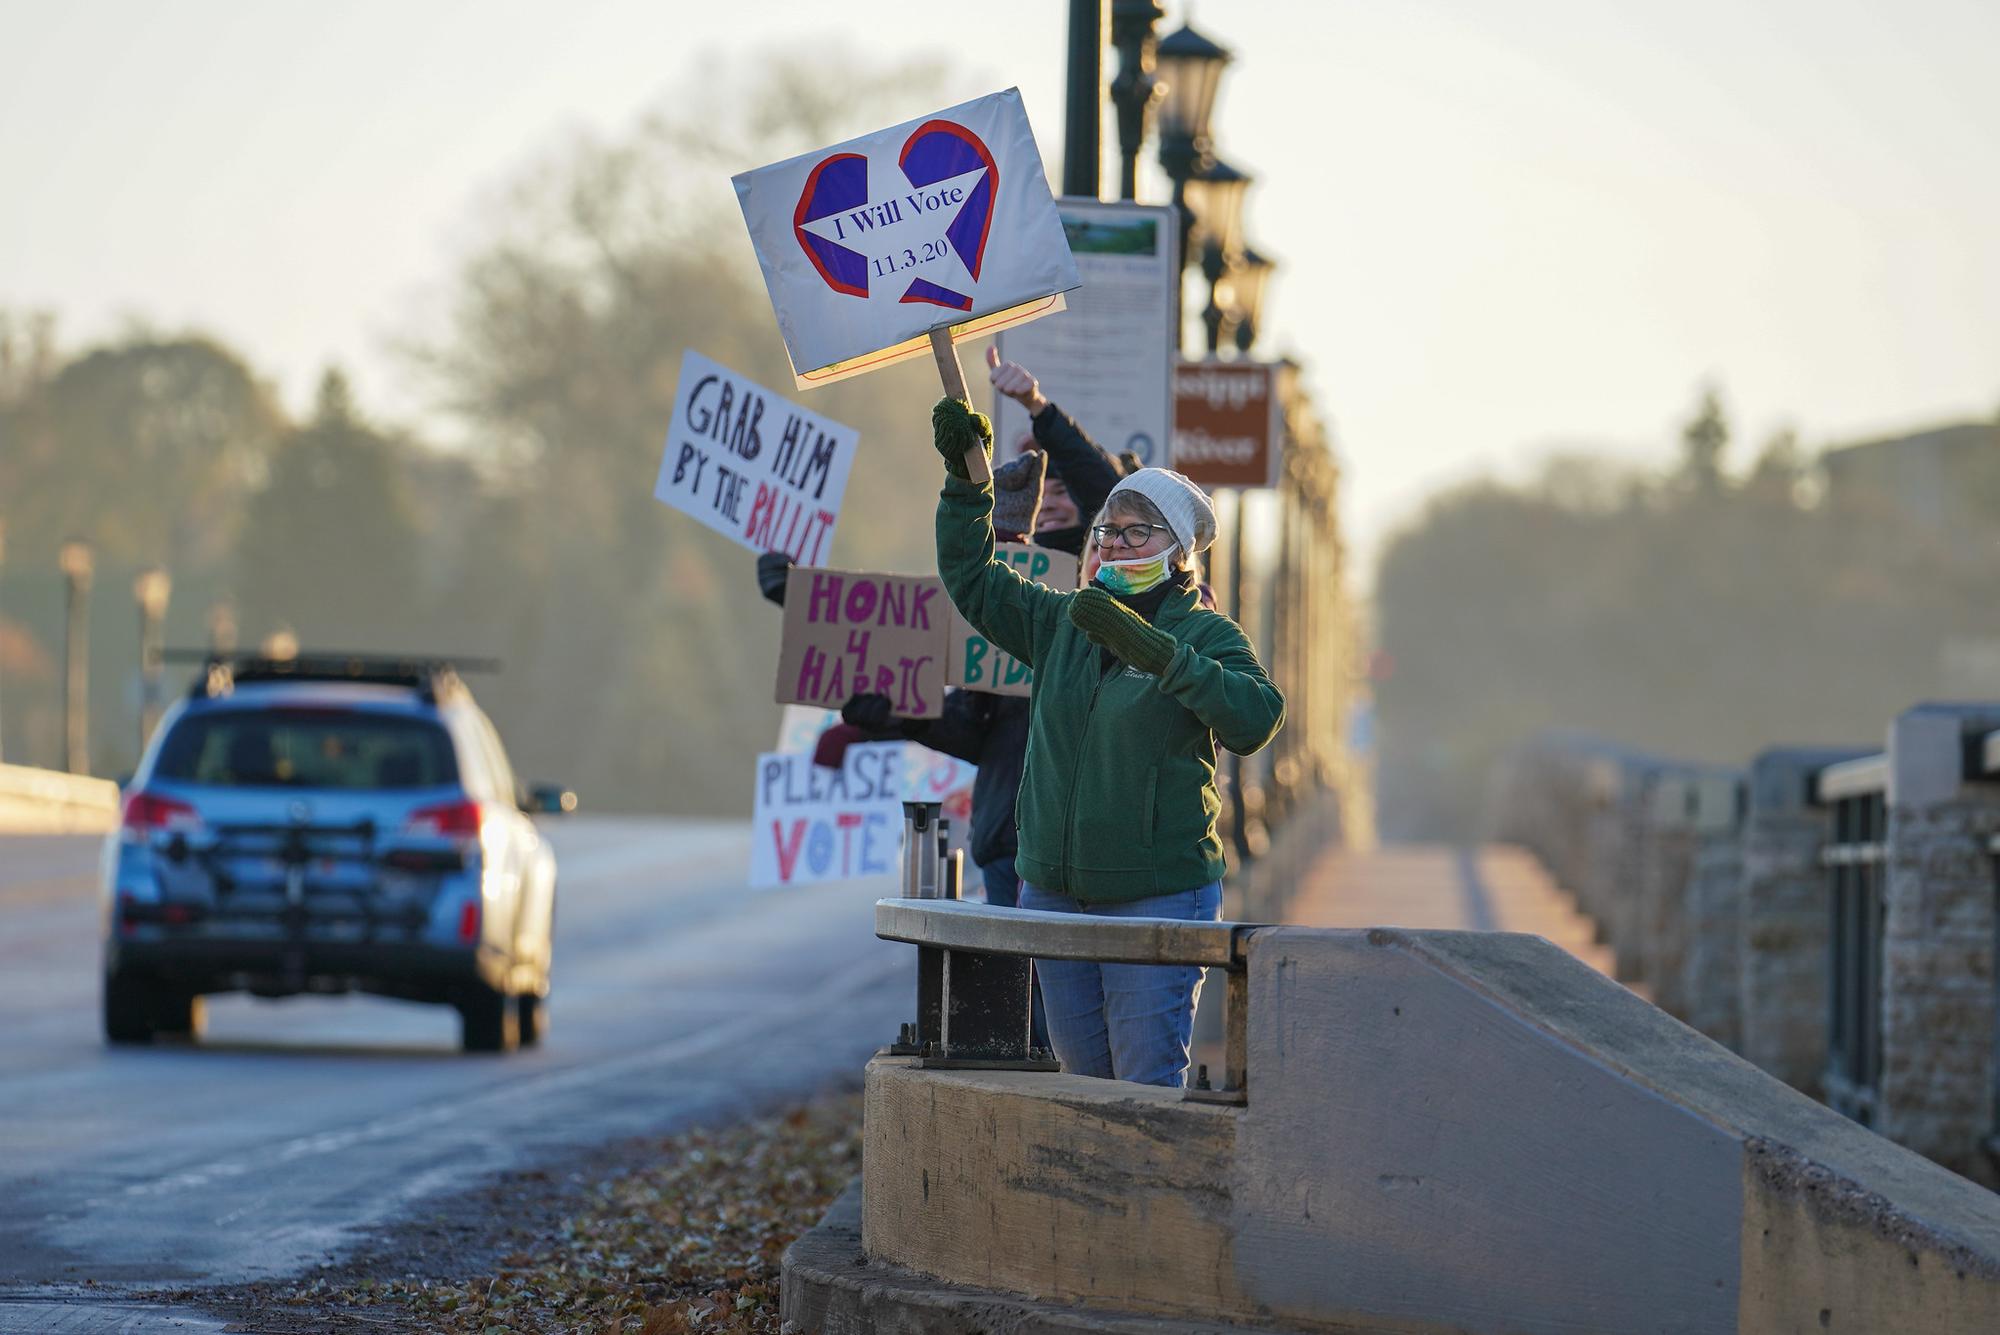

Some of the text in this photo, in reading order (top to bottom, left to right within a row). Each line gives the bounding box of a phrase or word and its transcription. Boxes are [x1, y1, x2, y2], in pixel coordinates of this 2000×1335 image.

[833, 187, 964, 240] I Will Vote
[872, 239, 948, 277] 11.3.20
[687, 374, 837, 500] GRAB HIM
[673, 442, 709, 495] BY
[712, 465, 749, 524] THE
[807, 573, 938, 631] HONK
[846, 629, 871, 673] 4
[764, 750, 898, 807] PLEASE
[772, 811, 887, 885] VOTE
